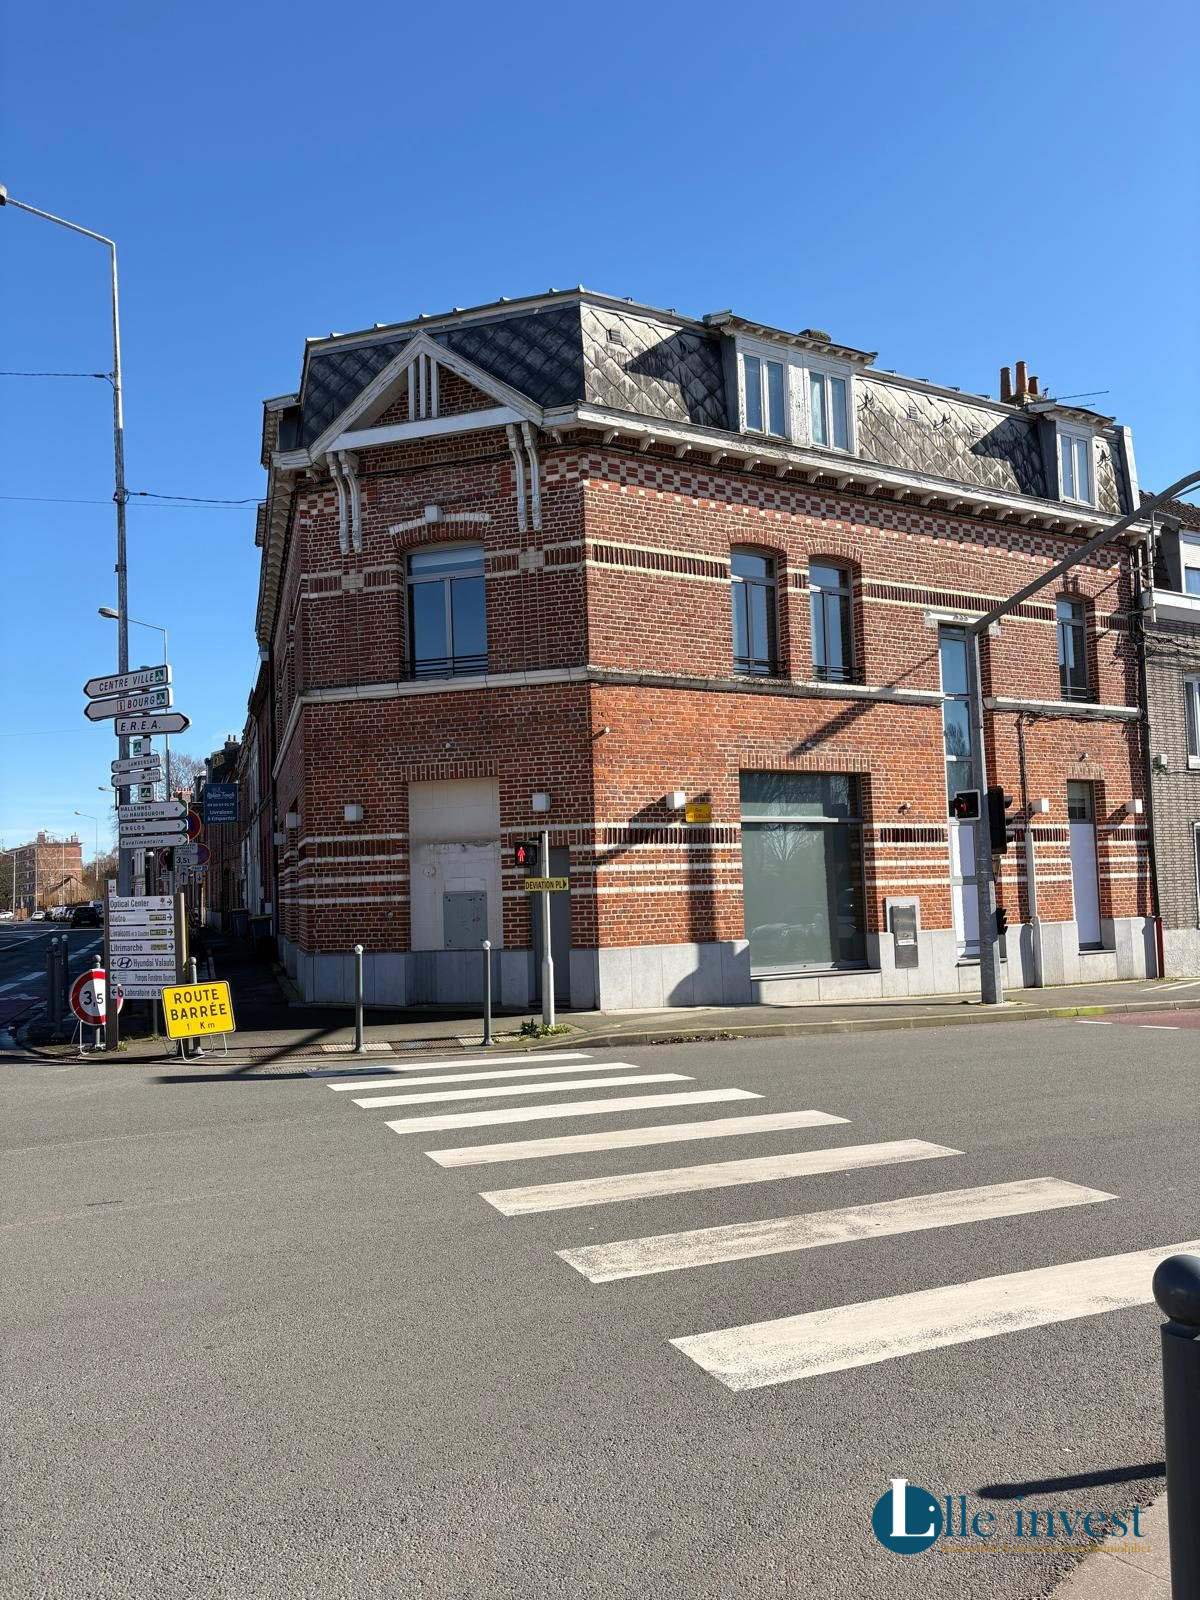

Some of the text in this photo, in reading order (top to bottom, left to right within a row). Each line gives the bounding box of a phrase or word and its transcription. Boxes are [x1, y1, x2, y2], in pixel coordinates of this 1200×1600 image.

[99, 673, 154, 691] CENTRE VILLE
[127, 696, 155, 709] BOURG
[121, 720, 161, 731] E.R.E.A.
[525, 880, 562, 890] DEVIATION PL
[110, 900, 149, 909] Optical Center
[133, 959, 154, 968] Hyundai
[83, 990, 104, 1008] 3,5
[174, 988, 220, 1004] ROUTE
[170, 1002, 227, 1021] BARRÉE
